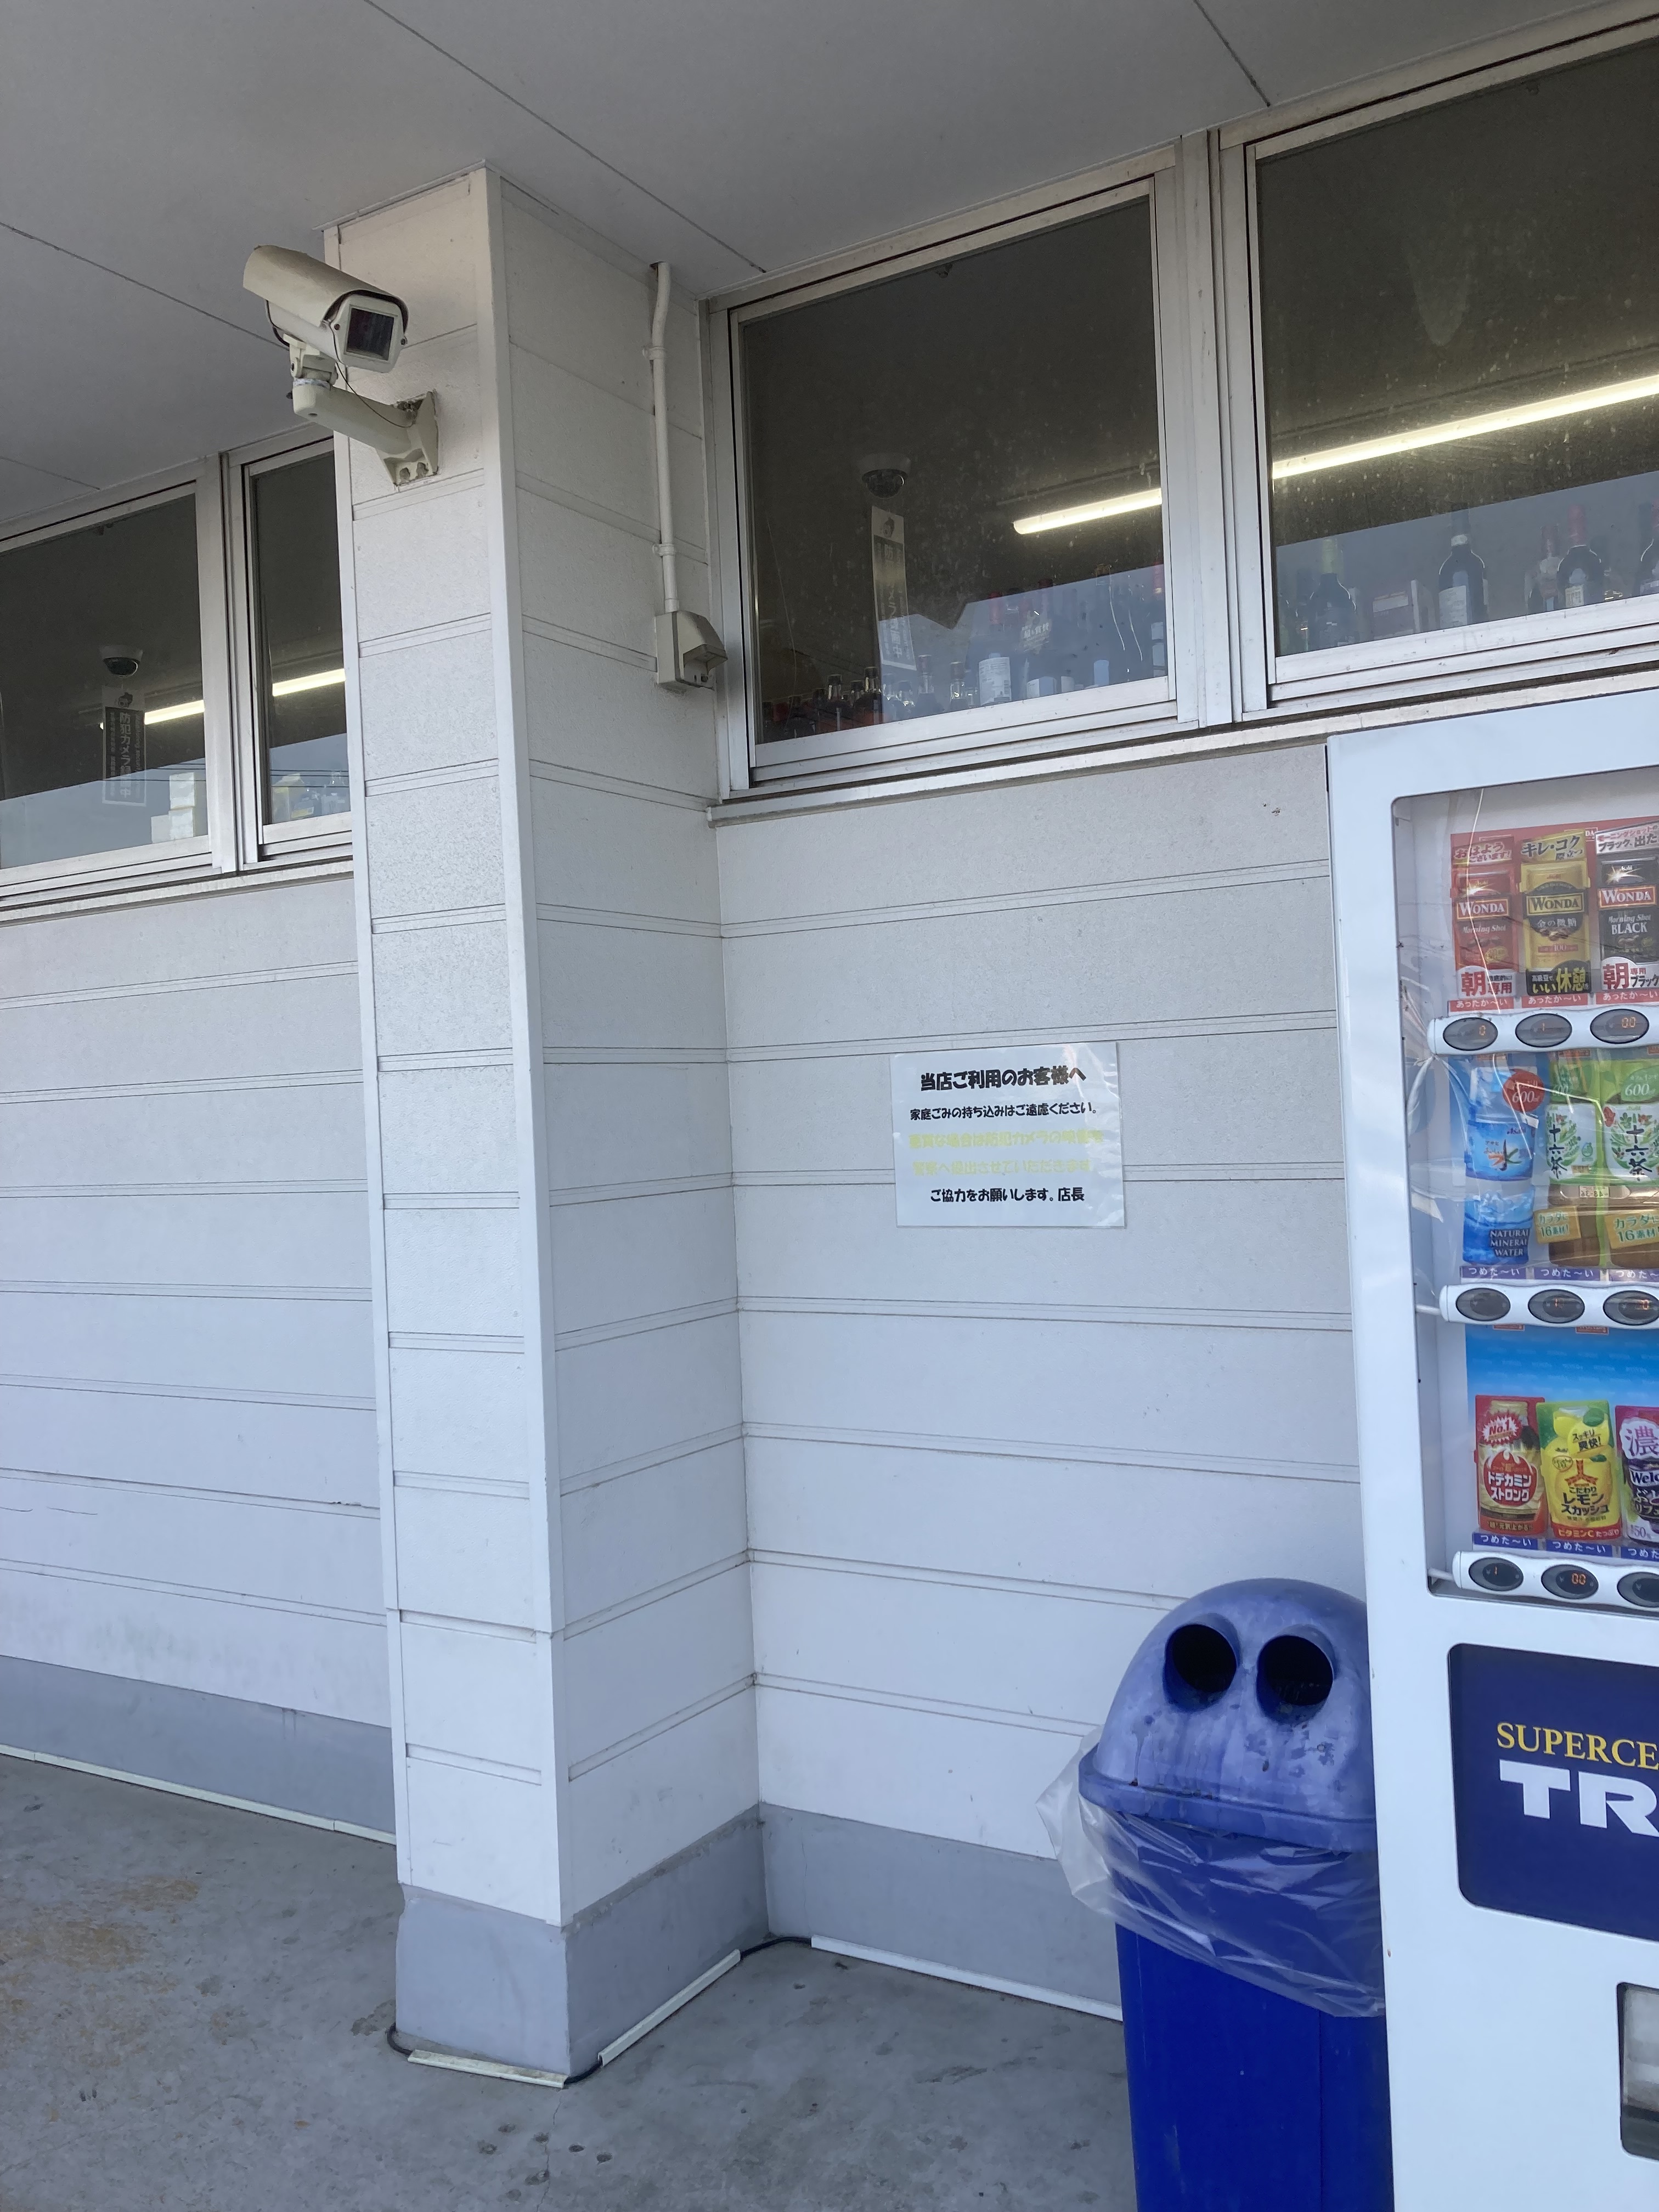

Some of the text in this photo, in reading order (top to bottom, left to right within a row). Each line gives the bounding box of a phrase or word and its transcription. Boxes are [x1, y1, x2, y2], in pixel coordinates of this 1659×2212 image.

[1531, 897, 1579, 911] WONDA
[1601, 889, 1651, 904] WONDA
[1459, 901, 1505, 916] WONDA
[1611, 922, 1647, 935] BLACK
[921, 1065, 1086, 1091] 当店ご利用のお客様へ
[910, 1102, 1096, 1120] 家庭ごみの持ち込みはご遠慮ください。
[1549, 1124, 1567, 1180] 十六茶
[1625, 1425, 1659, 1457] 濃
[1488, 1471, 1531, 1487] ドデカミン
[1491, 1487, 1530, 1502] ストロング
[1563, 1492, 1604, 1505] レモン
[1561, 1504, 1610, 1515] スカッシュ
[1497, 1722, 1659, 1770] SUPERCE
[1499, 1759, 1659, 1837] TR
